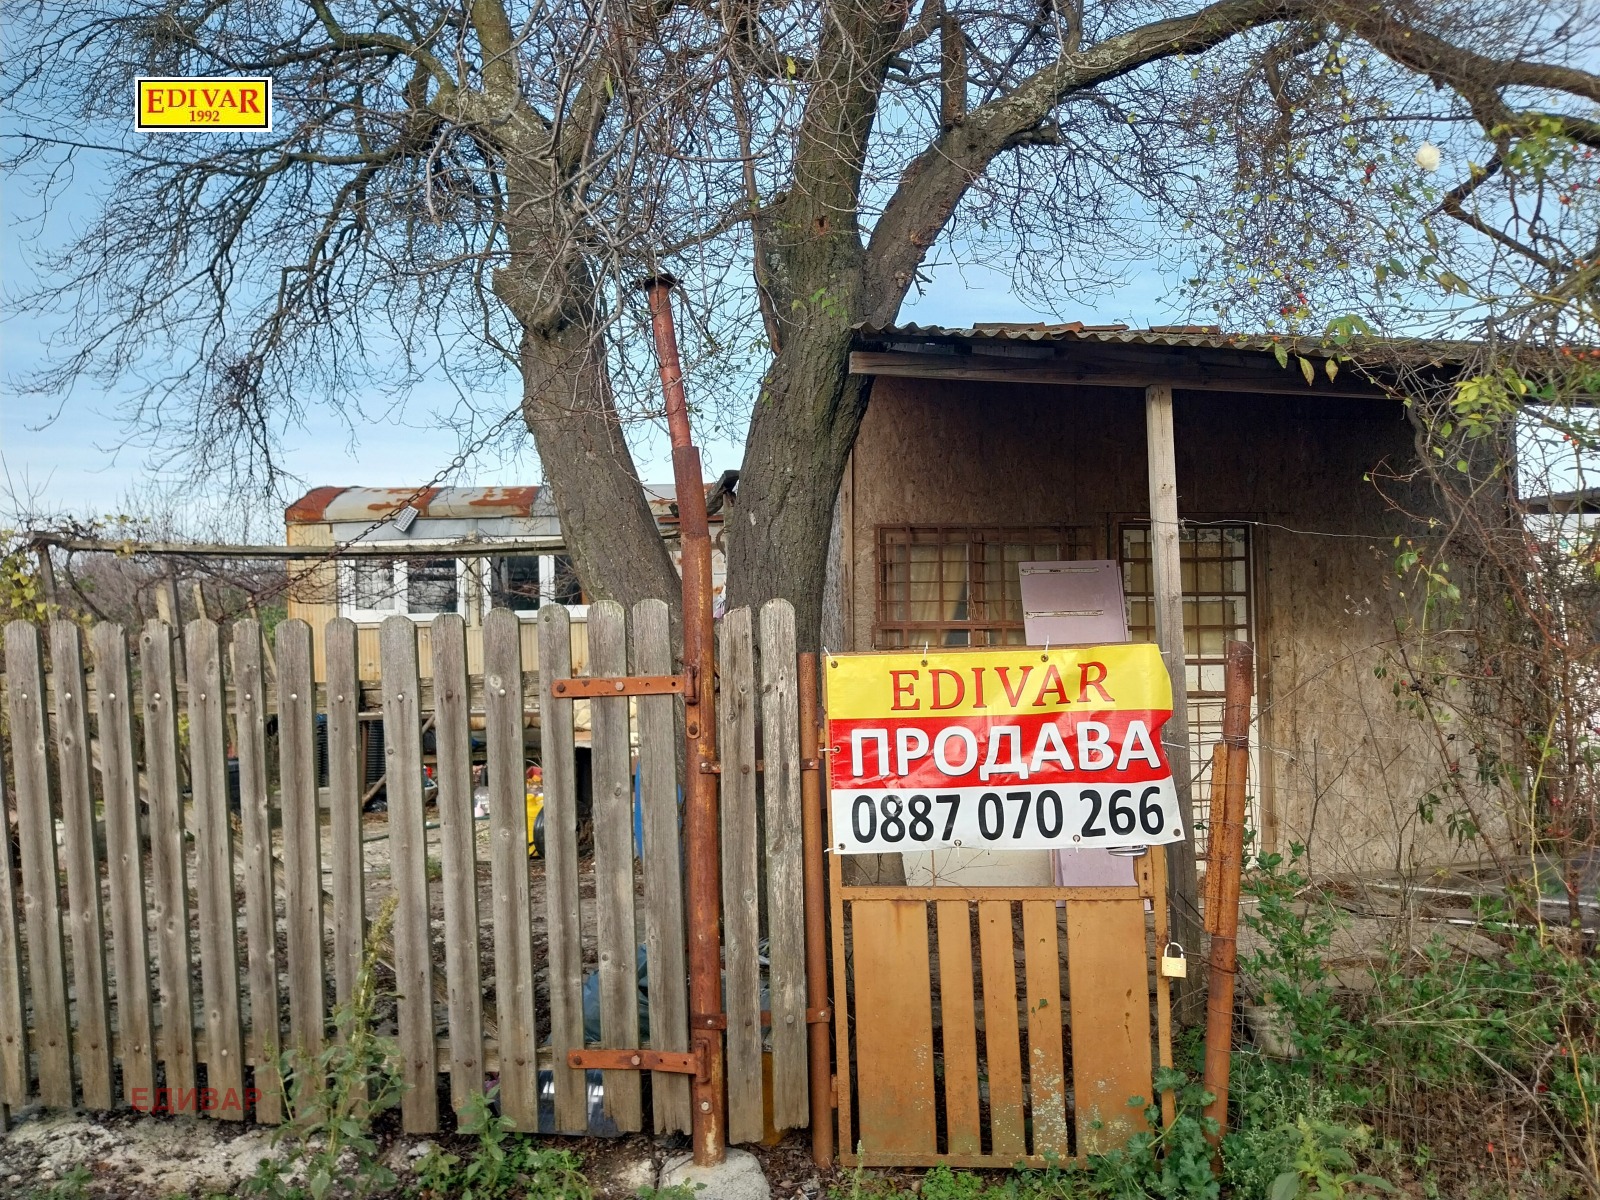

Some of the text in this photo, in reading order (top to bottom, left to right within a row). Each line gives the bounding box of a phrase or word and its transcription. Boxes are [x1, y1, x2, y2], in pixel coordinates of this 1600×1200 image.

[889, 661, 1115, 711] EDIVAR
[850, 720, 1161, 781] ПРОДАВА
[851, 786, 1164, 843] 0887 070 266
